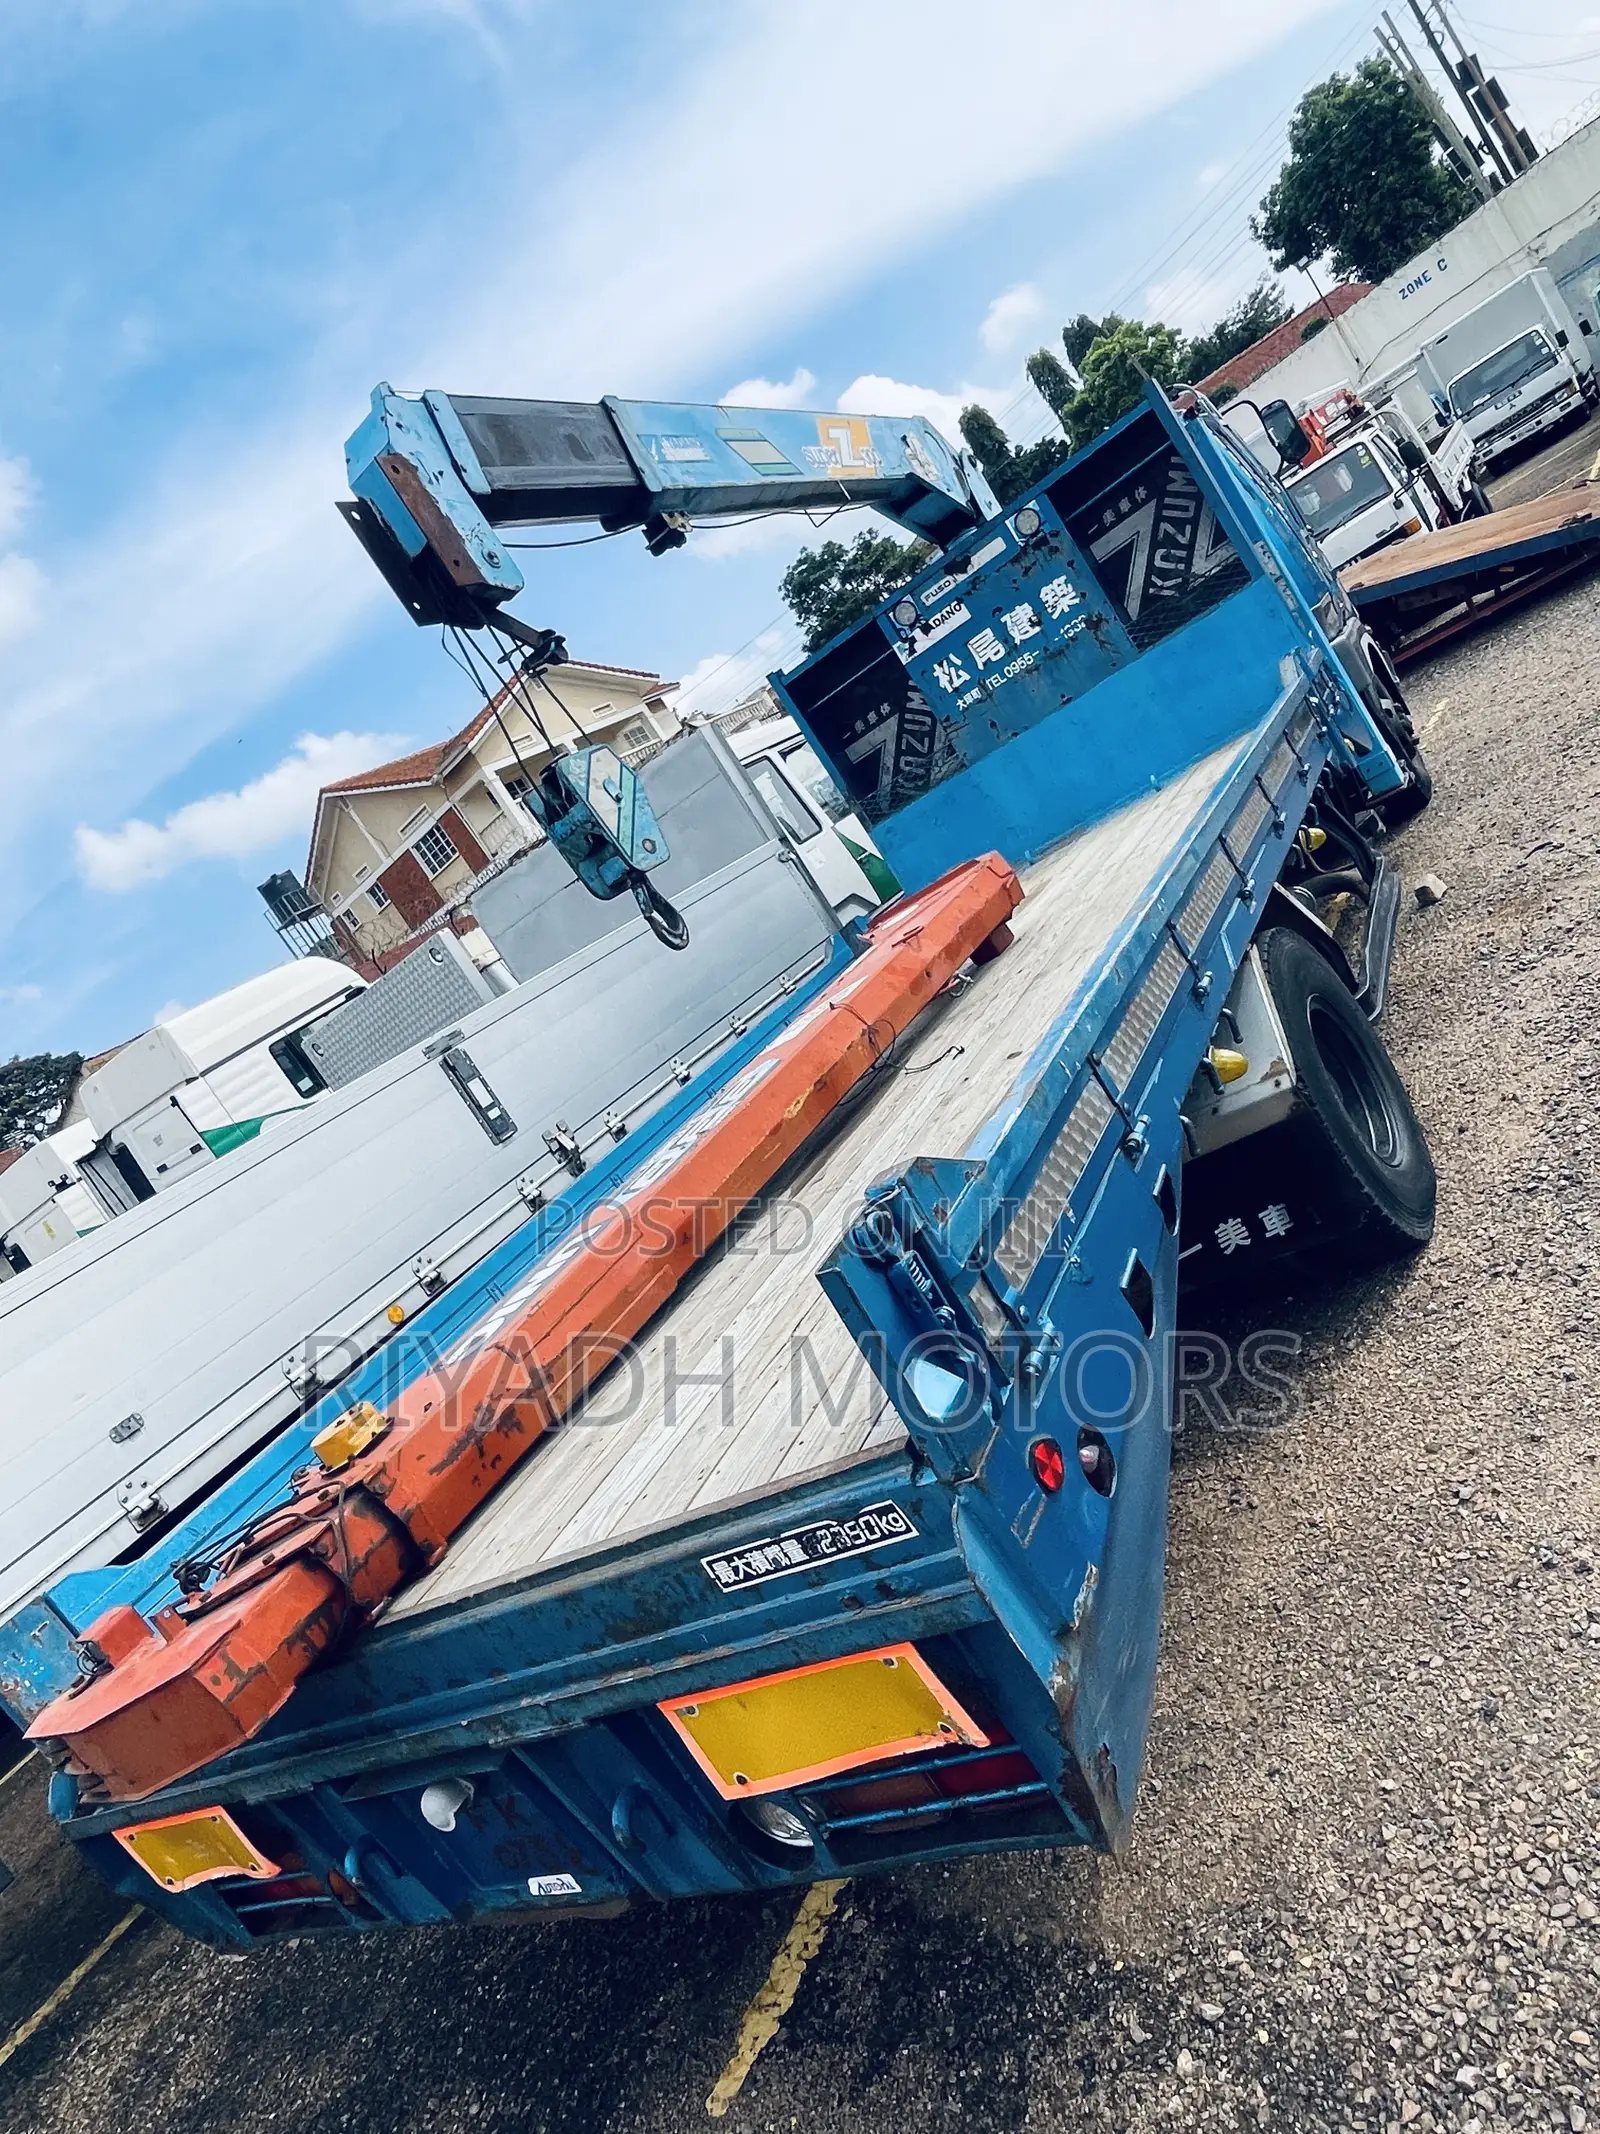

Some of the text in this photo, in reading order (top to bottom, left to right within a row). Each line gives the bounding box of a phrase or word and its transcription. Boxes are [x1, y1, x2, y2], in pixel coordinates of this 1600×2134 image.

[1398, 258, 1447, 300] ZONE C
[923, 578, 952, 602] FUSO
[932, 575, 1081, 694] 松尾建築
